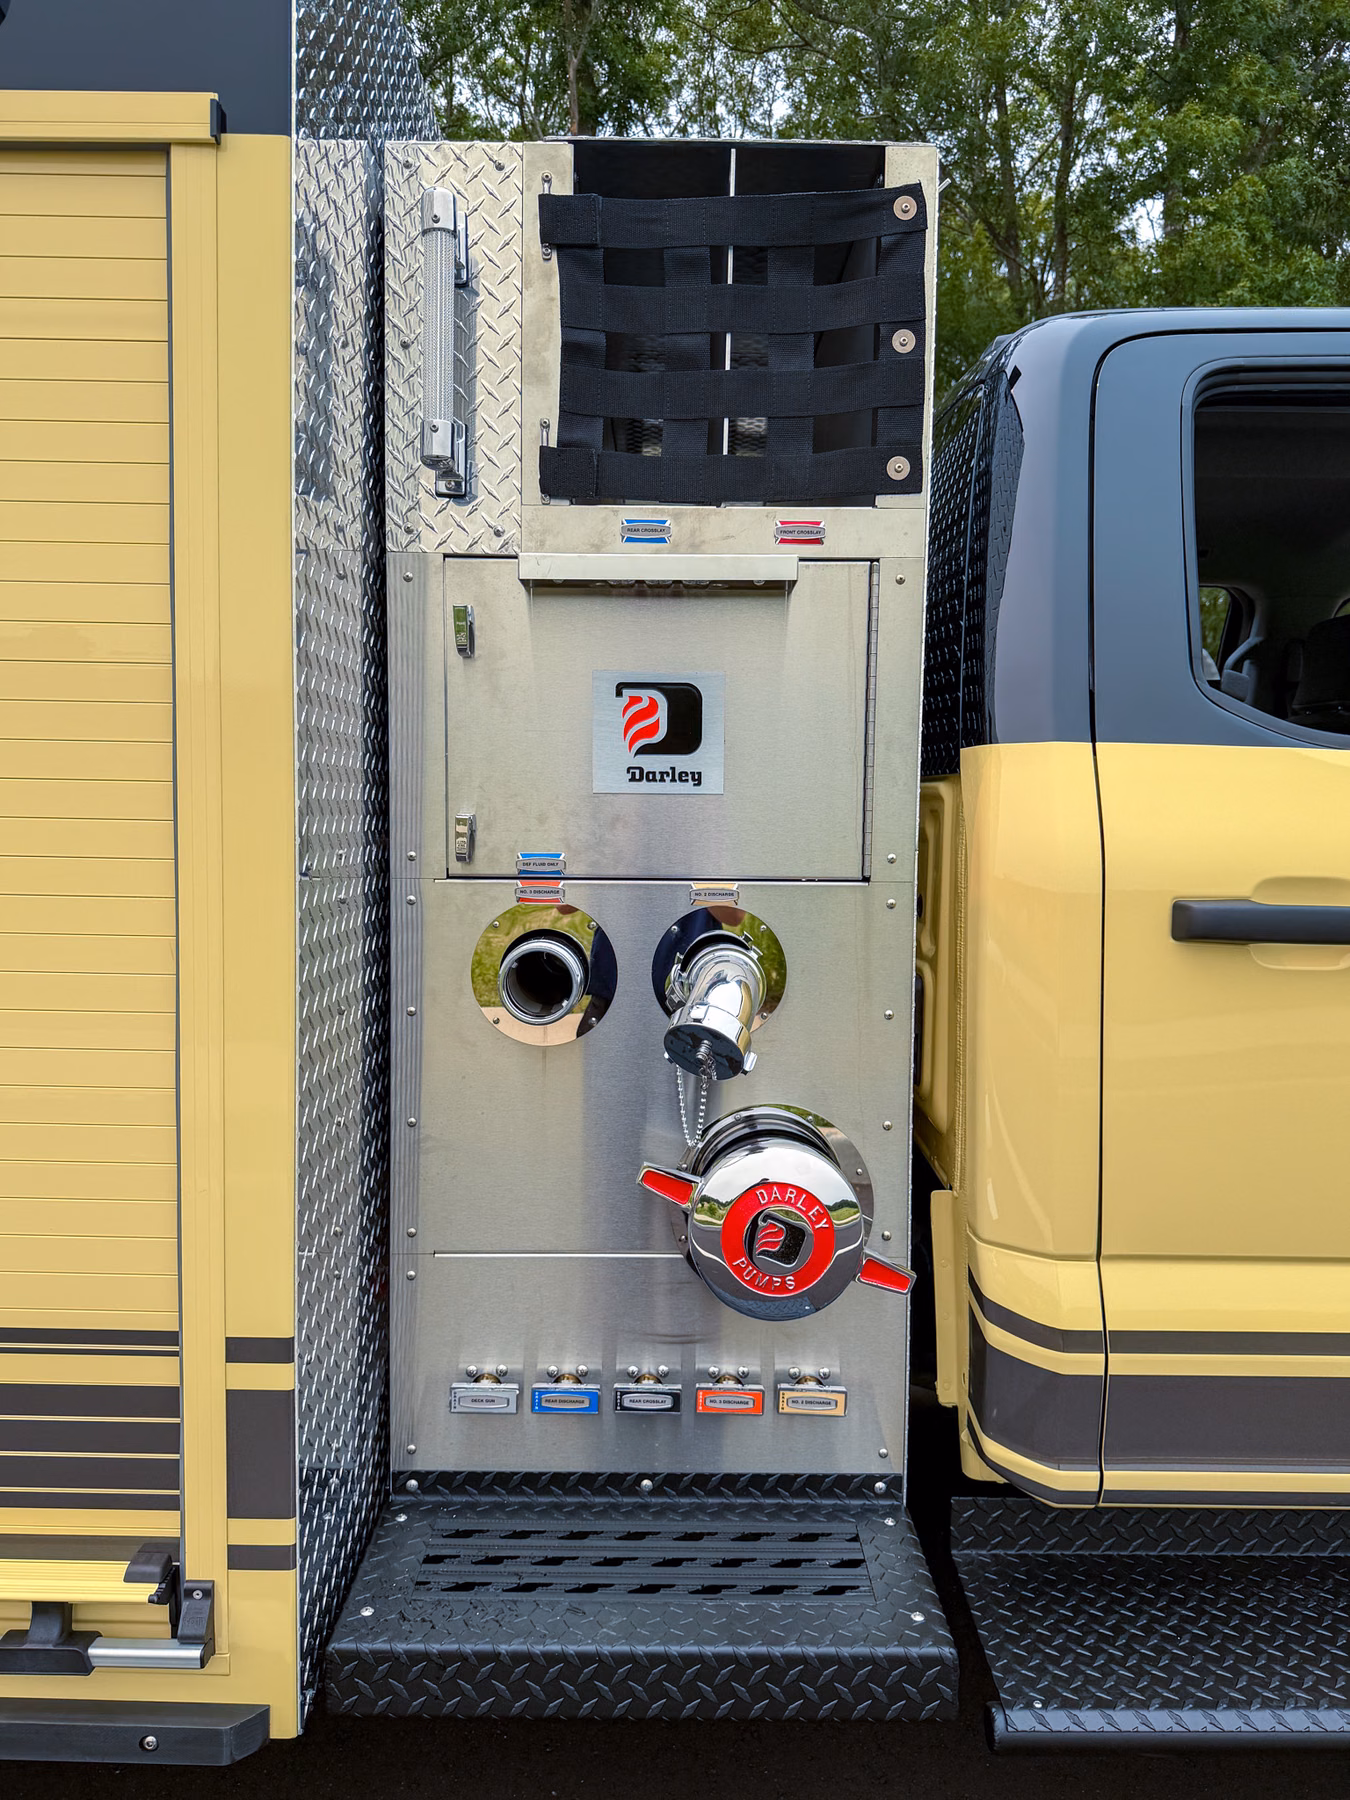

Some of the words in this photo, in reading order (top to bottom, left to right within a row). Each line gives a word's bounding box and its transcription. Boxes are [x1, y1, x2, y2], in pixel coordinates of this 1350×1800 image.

[626, 766, 702, 787] Darley
[755, 1186, 830, 1229] DARLEY
[732, 1257, 796, 1290] PUMPS
